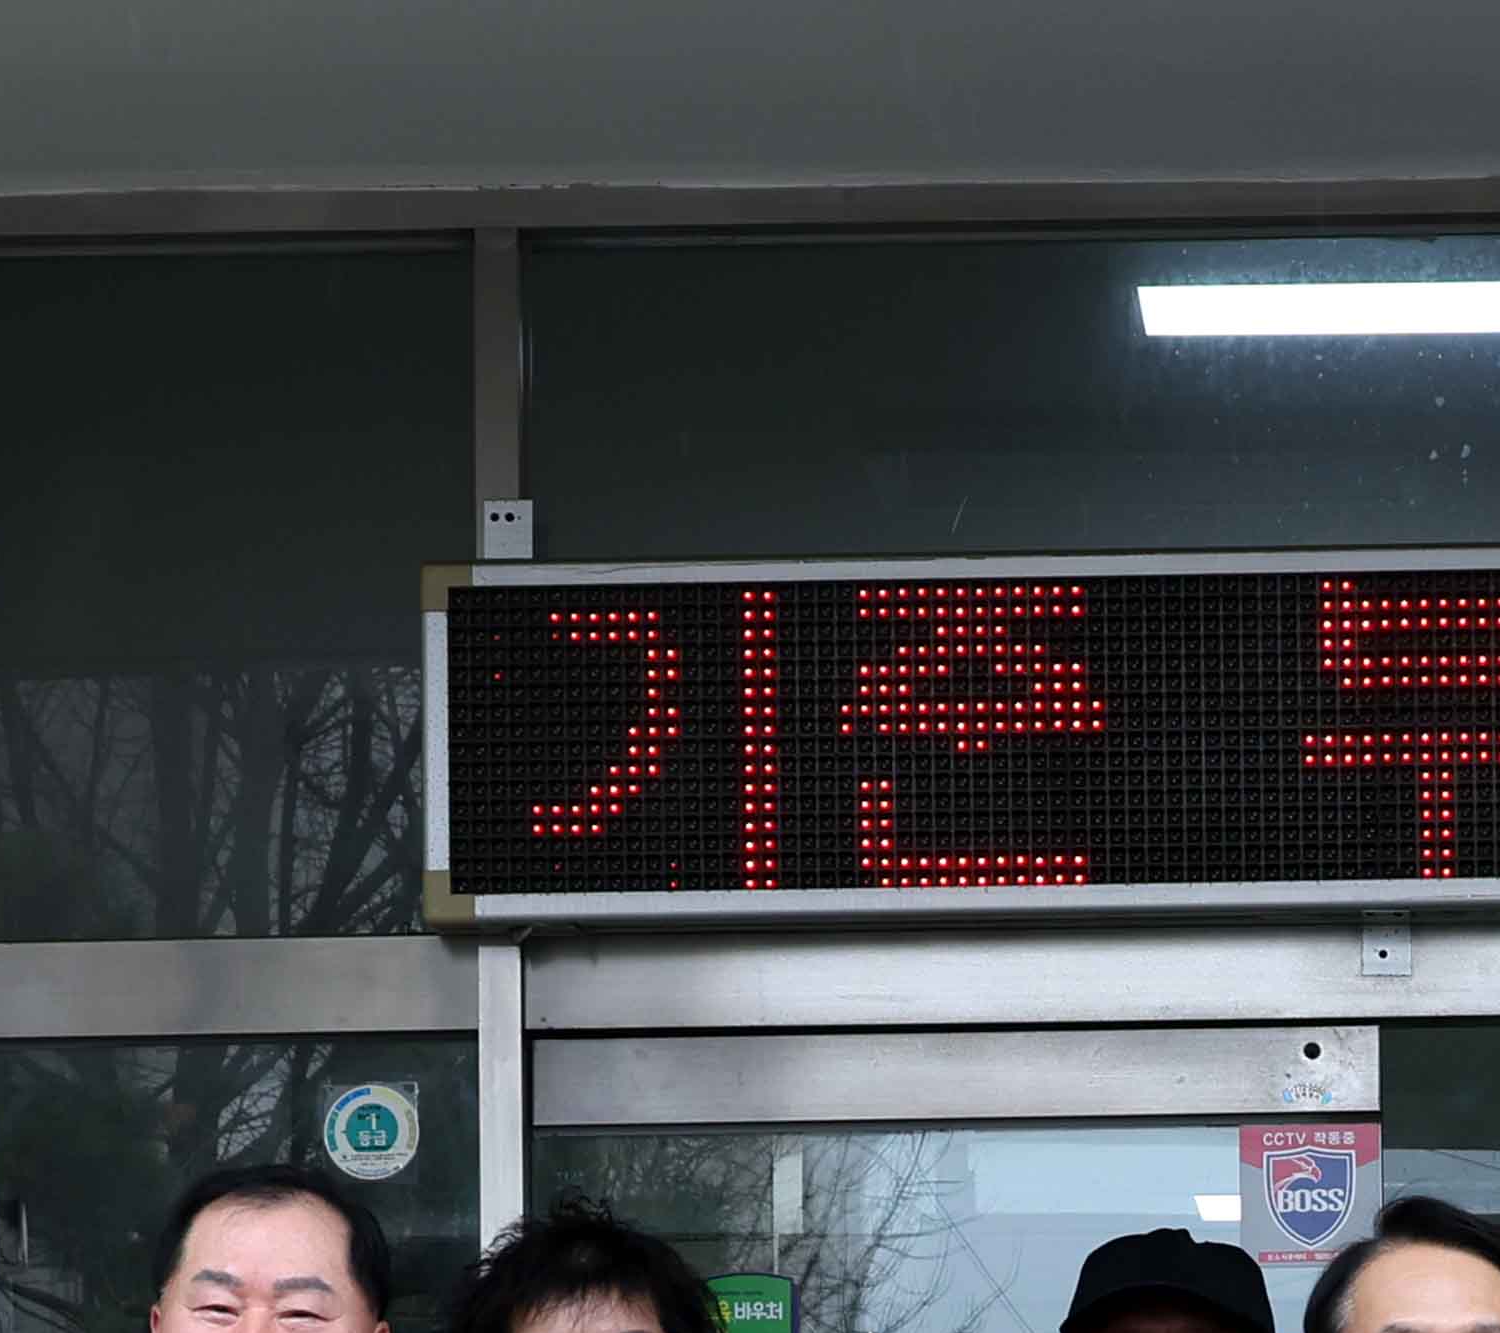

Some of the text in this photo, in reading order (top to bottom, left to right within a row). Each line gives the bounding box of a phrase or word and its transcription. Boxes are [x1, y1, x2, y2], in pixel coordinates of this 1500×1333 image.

[1262, 1130, 1357, 1146] CCTV 작동중
[1276, 1187, 1345, 1213] BOSS
[733, 1300, 784, 1321] 바우처
